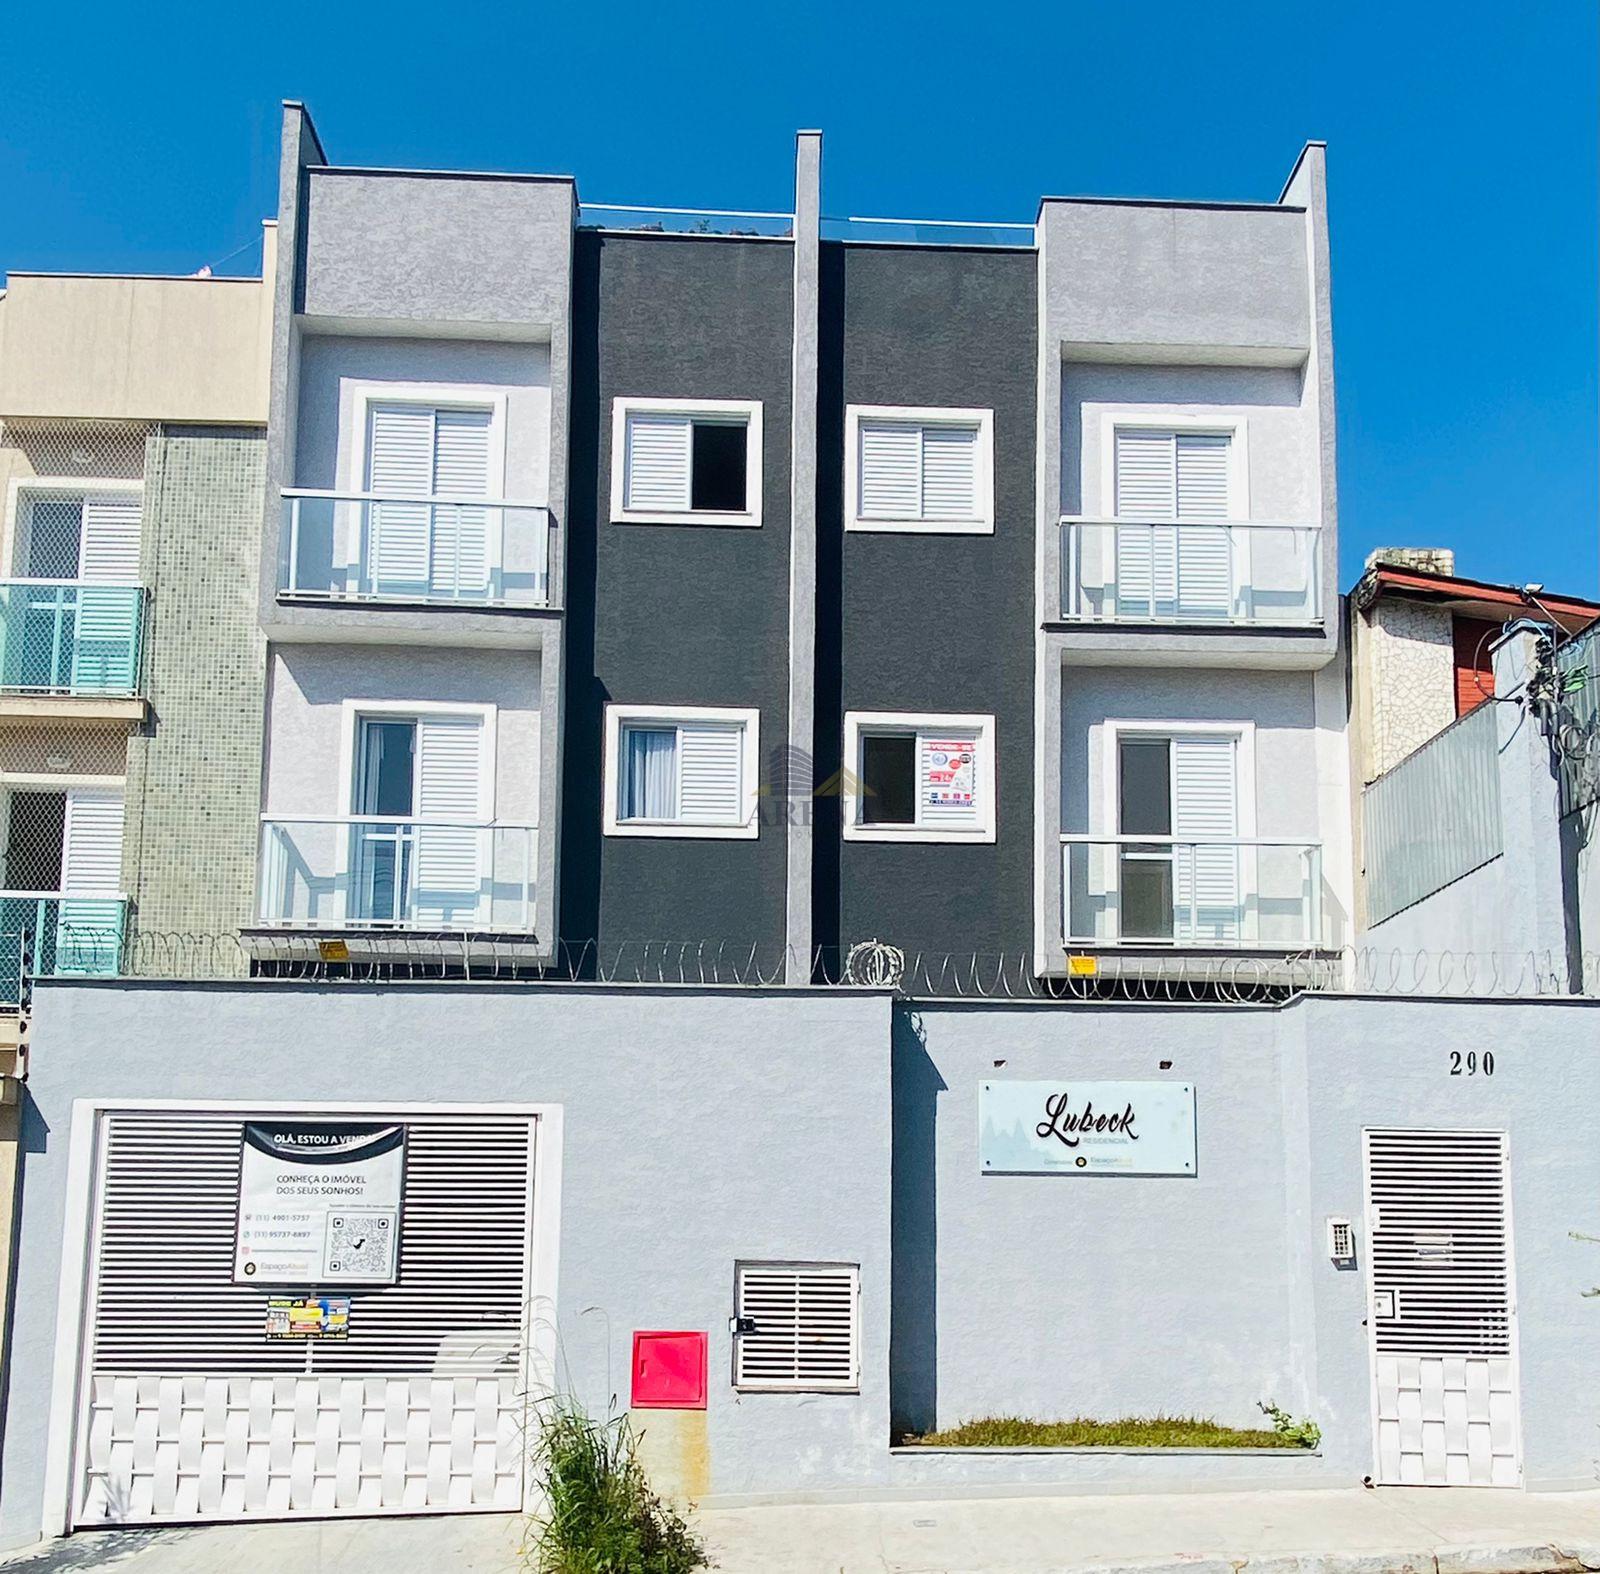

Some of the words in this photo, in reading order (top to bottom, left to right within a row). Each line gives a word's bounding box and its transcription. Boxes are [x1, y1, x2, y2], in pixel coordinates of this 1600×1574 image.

[1449, 1051, 1494, 1076] 290
[1036, 1092, 1139, 1148] Lubeck
[273, 1133, 297, 1145] OLÁ,
[298, 1135, 329, 1145] ESTOU
[330, 1136, 338, 1145] A
[1082, 1137, 1129, 1145] RESIDENCIAL
[276, 1175, 320, 1186] CONHEÇA
[321, 1176, 329, 1184] O
[331, 1174, 367, 1185] IMÓVEL
[276, 1186, 296, 1195] DOS
[297, 1187, 319, 1195] SEUS
[320, 1187, 363, 1196] SONHOS!
